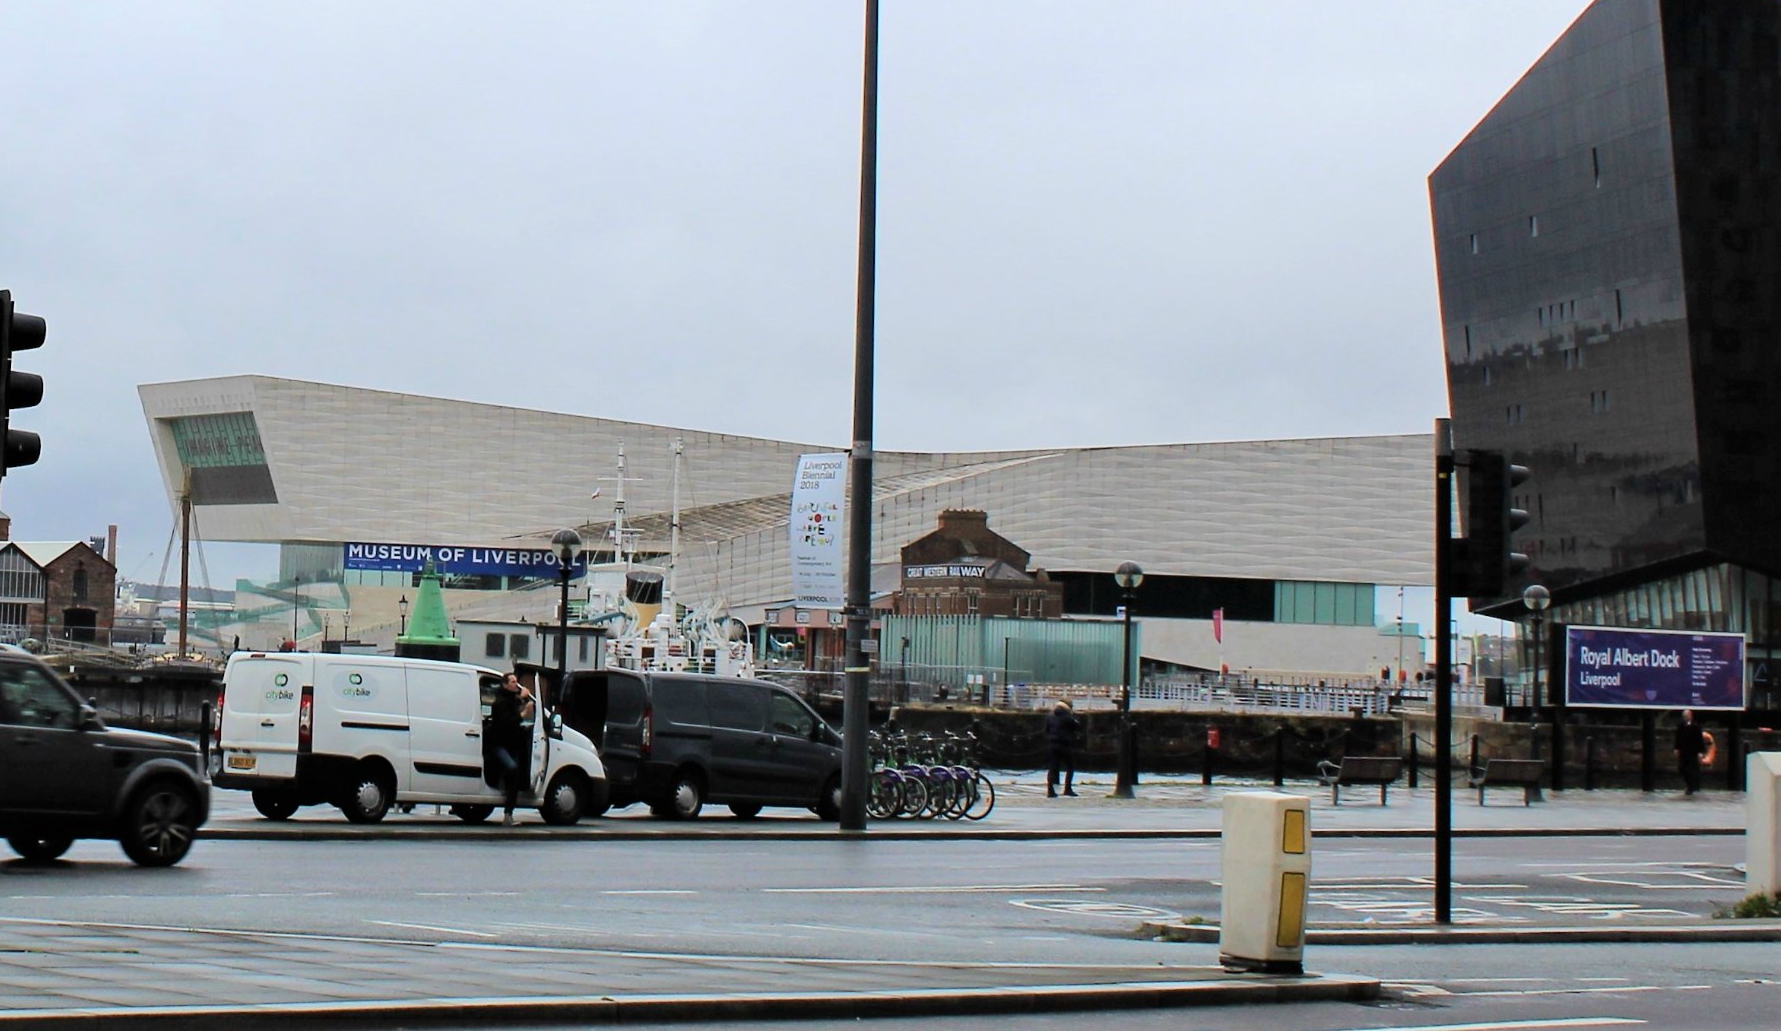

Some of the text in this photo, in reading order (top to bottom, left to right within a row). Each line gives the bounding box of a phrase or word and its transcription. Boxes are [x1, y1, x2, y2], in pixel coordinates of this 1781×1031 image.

[804, 461, 842, 471] Liverpool
[802, 471, 835, 480] Biennial
[800, 480, 820, 490] 2018
[348, 544, 581, 566] MUSEUM OF LIVERPOL
[949, 566, 985, 578] RAILWAY
[1581, 646, 1680, 669] Royal Albert Dock
[1580, 671, 1621, 688] Liverpool
[266, 690, 294, 701] citybike
[343, 688, 371, 699] citybike
